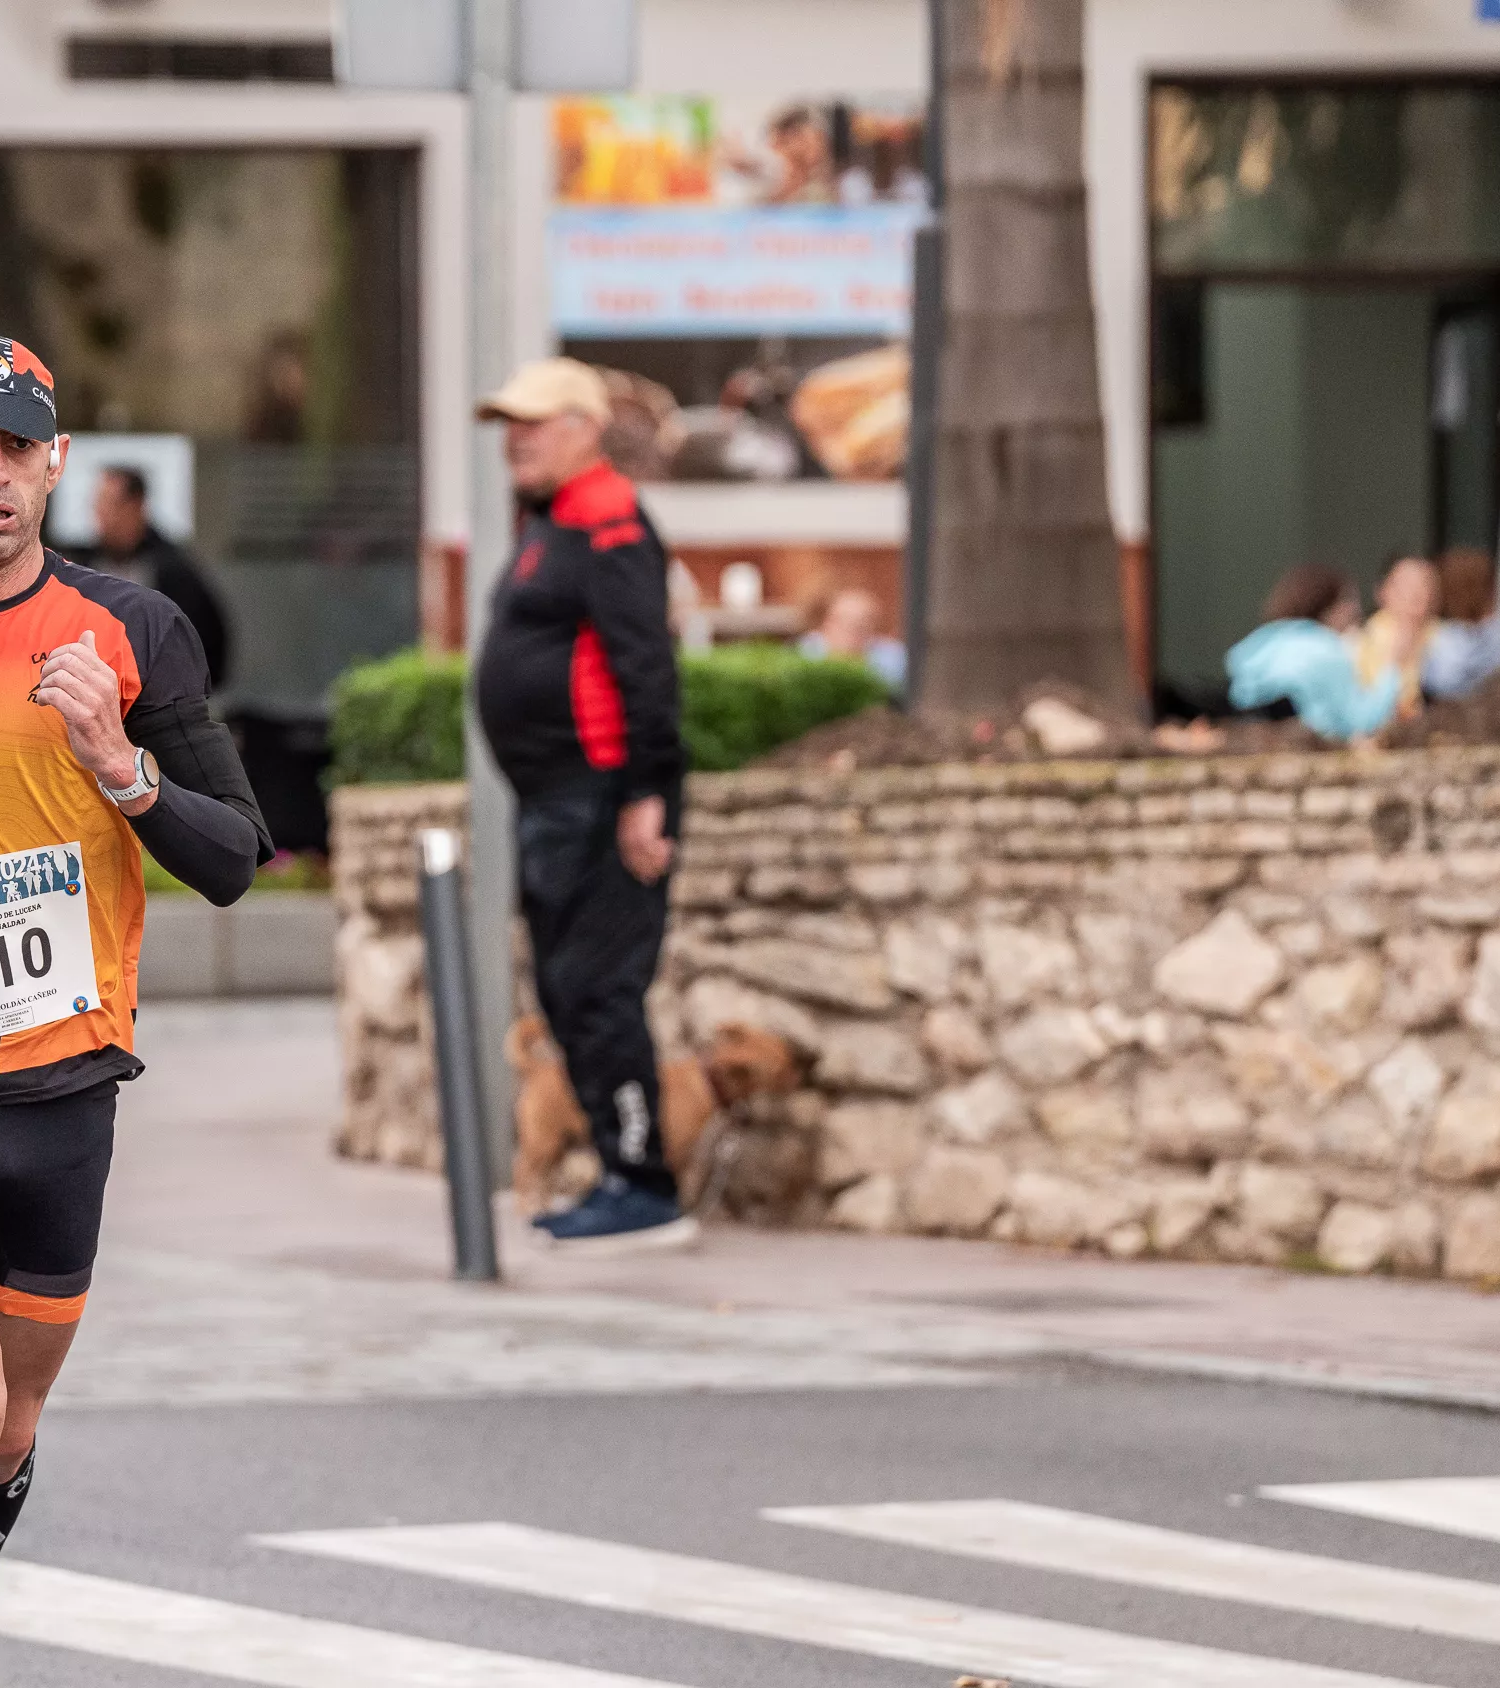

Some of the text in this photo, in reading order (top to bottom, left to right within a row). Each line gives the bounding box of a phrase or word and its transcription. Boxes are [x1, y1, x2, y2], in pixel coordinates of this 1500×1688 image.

[4, 911, 14, 919] DE
[15, 903, 42, 916] LUCENA
[27, 988, 57, 1003] CAÑERO
